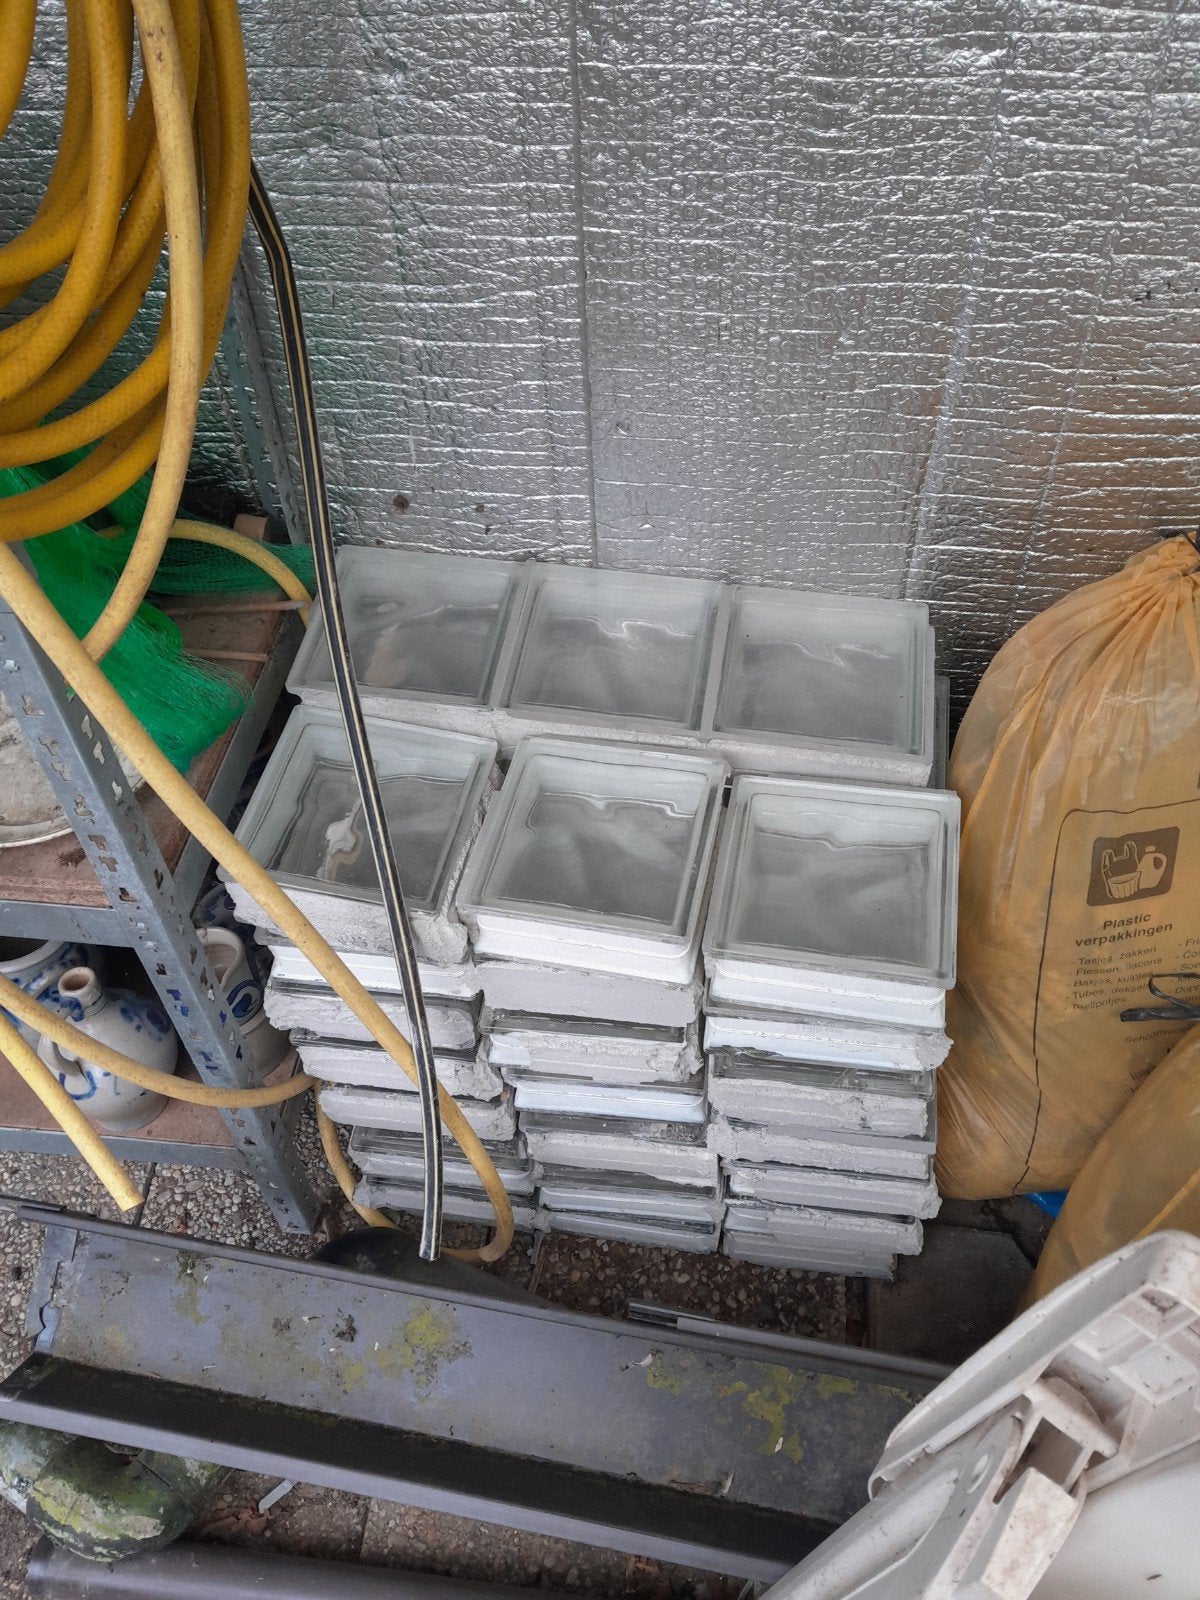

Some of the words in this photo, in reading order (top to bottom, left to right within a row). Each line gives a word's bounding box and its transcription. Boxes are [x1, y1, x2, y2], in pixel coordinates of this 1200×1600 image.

[1103, 914, 1152, 930] Plastic
[1075, 923, 1173, 947] verpakkingen
[1120, 946, 1157, 960] zakken
